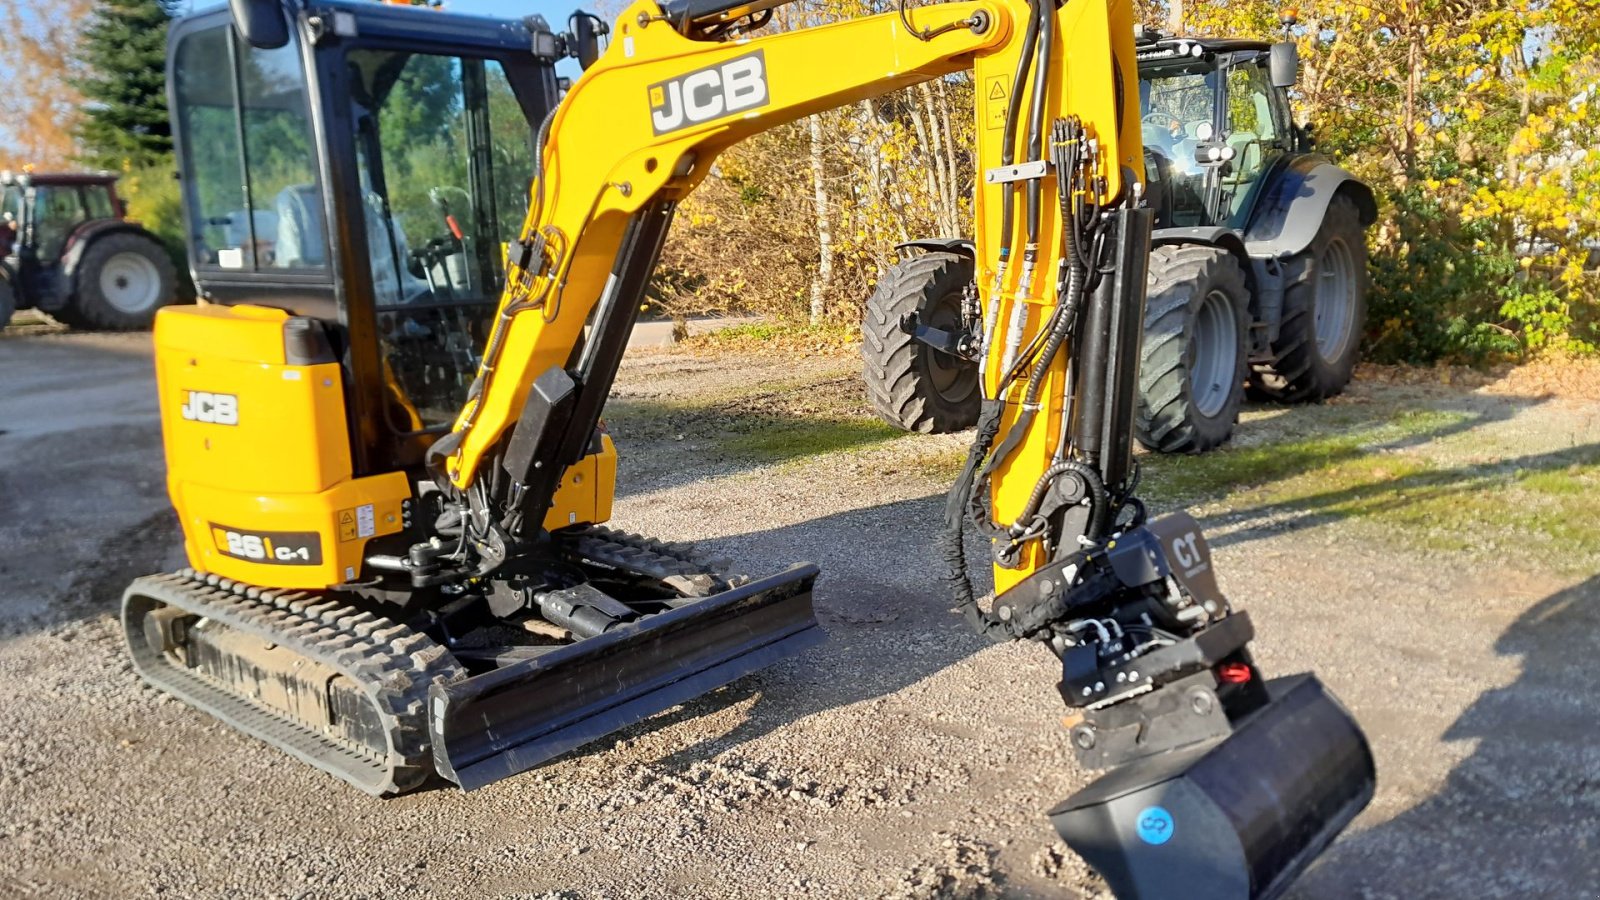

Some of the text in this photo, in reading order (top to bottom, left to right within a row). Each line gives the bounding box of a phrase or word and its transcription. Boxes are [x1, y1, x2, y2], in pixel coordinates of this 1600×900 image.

[652, 56, 766, 131] JCB
[182, 391, 238, 425] JCB
[226, 531, 310, 561] 26 C-1
[1172, 532, 1201, 568] CT
